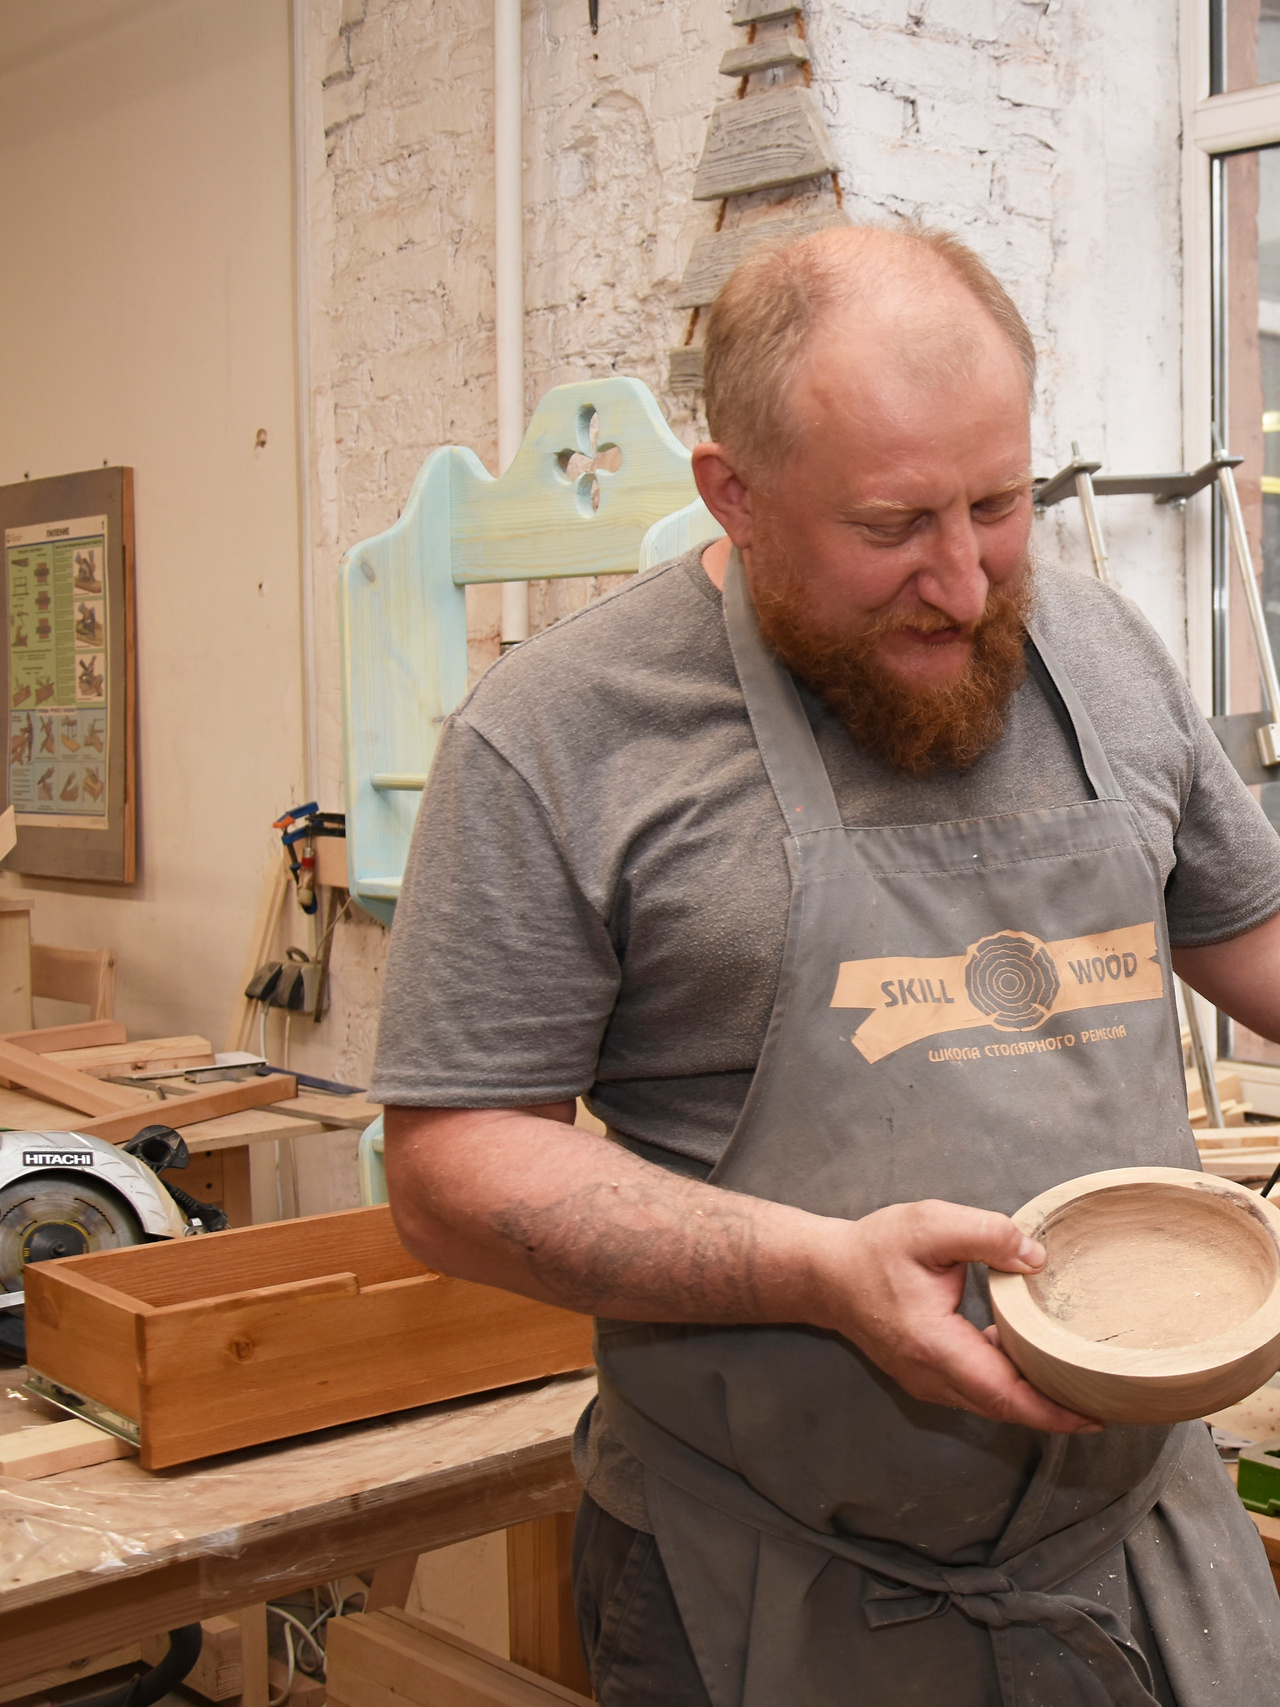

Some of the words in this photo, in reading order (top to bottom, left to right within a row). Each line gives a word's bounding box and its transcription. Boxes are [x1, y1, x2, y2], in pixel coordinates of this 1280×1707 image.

[880, 978, 955, 1007] SKILL
[1067, 952, 1137, 985] WOOD
[928, 1046, 981, 1063] ШКОЛА
[985, 1033, 1076, 1058] СТОЛЯРНОГО
[1081, 1025, 1127, 1044] РЕМЕСЛА
[25, 1153, 92, 1165] HITACHI
